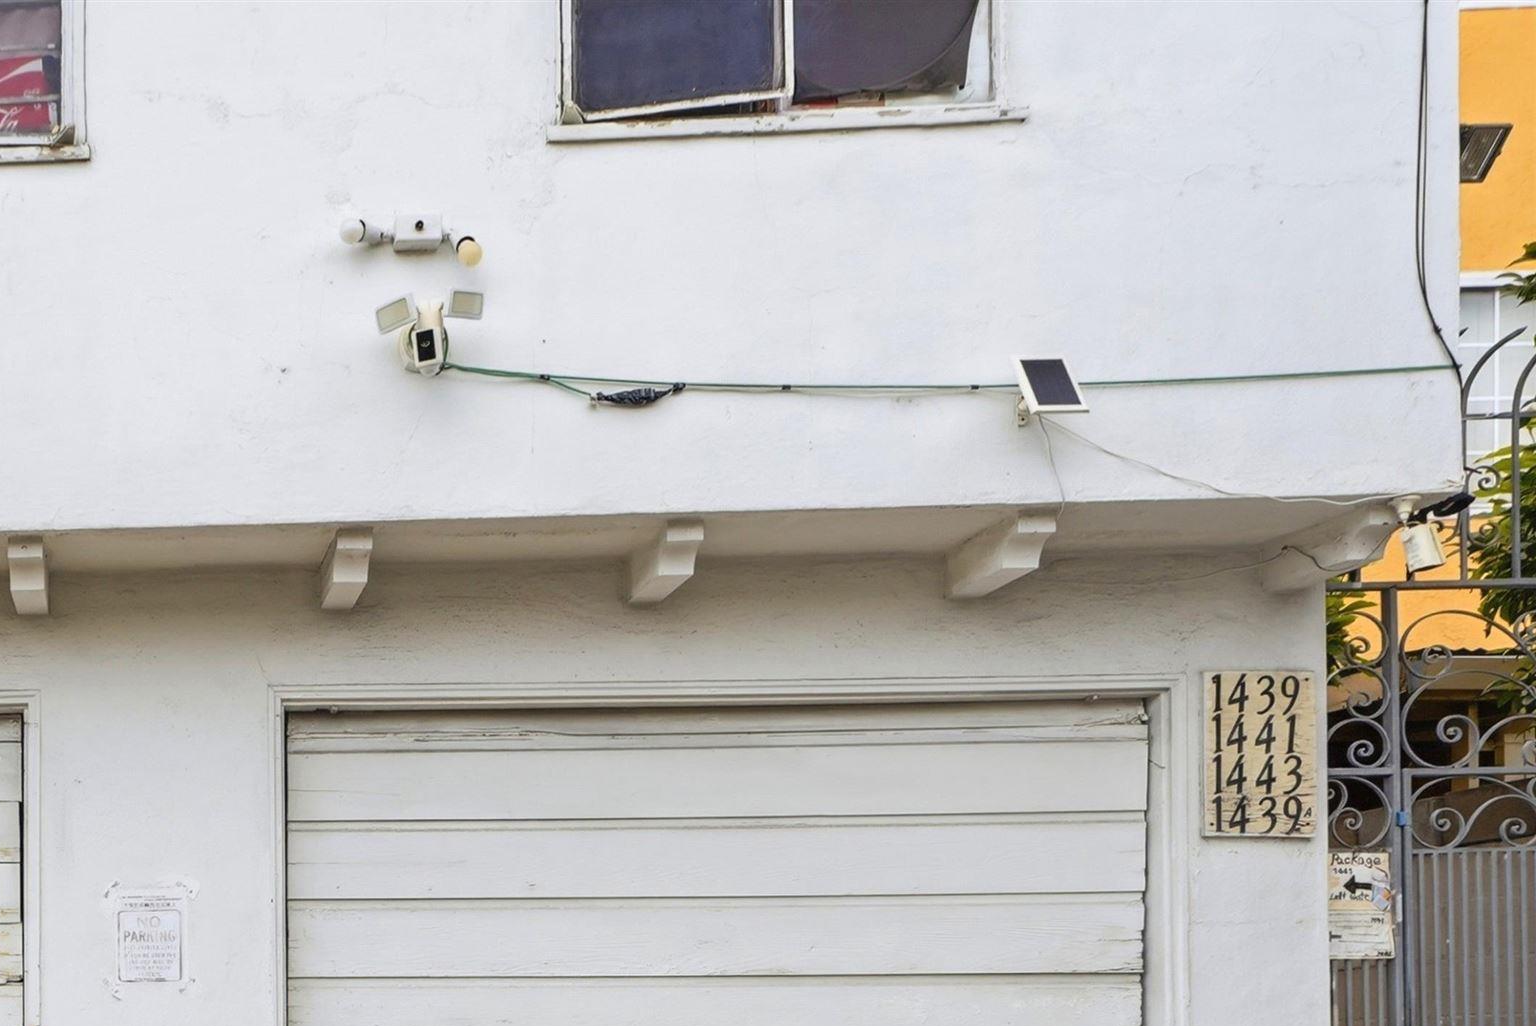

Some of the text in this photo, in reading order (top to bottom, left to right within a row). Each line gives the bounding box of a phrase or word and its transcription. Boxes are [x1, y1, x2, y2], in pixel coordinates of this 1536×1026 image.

[1211, 673, 1300, 715] 1439
[1211, 713, 1297, 754] 1441
[1212, 754, 1303, 795] 1443
[1330, 851, 1381, 868] Package
[136, 916, 161, 928] NO
[123, 931, 176, 943] PARKING
